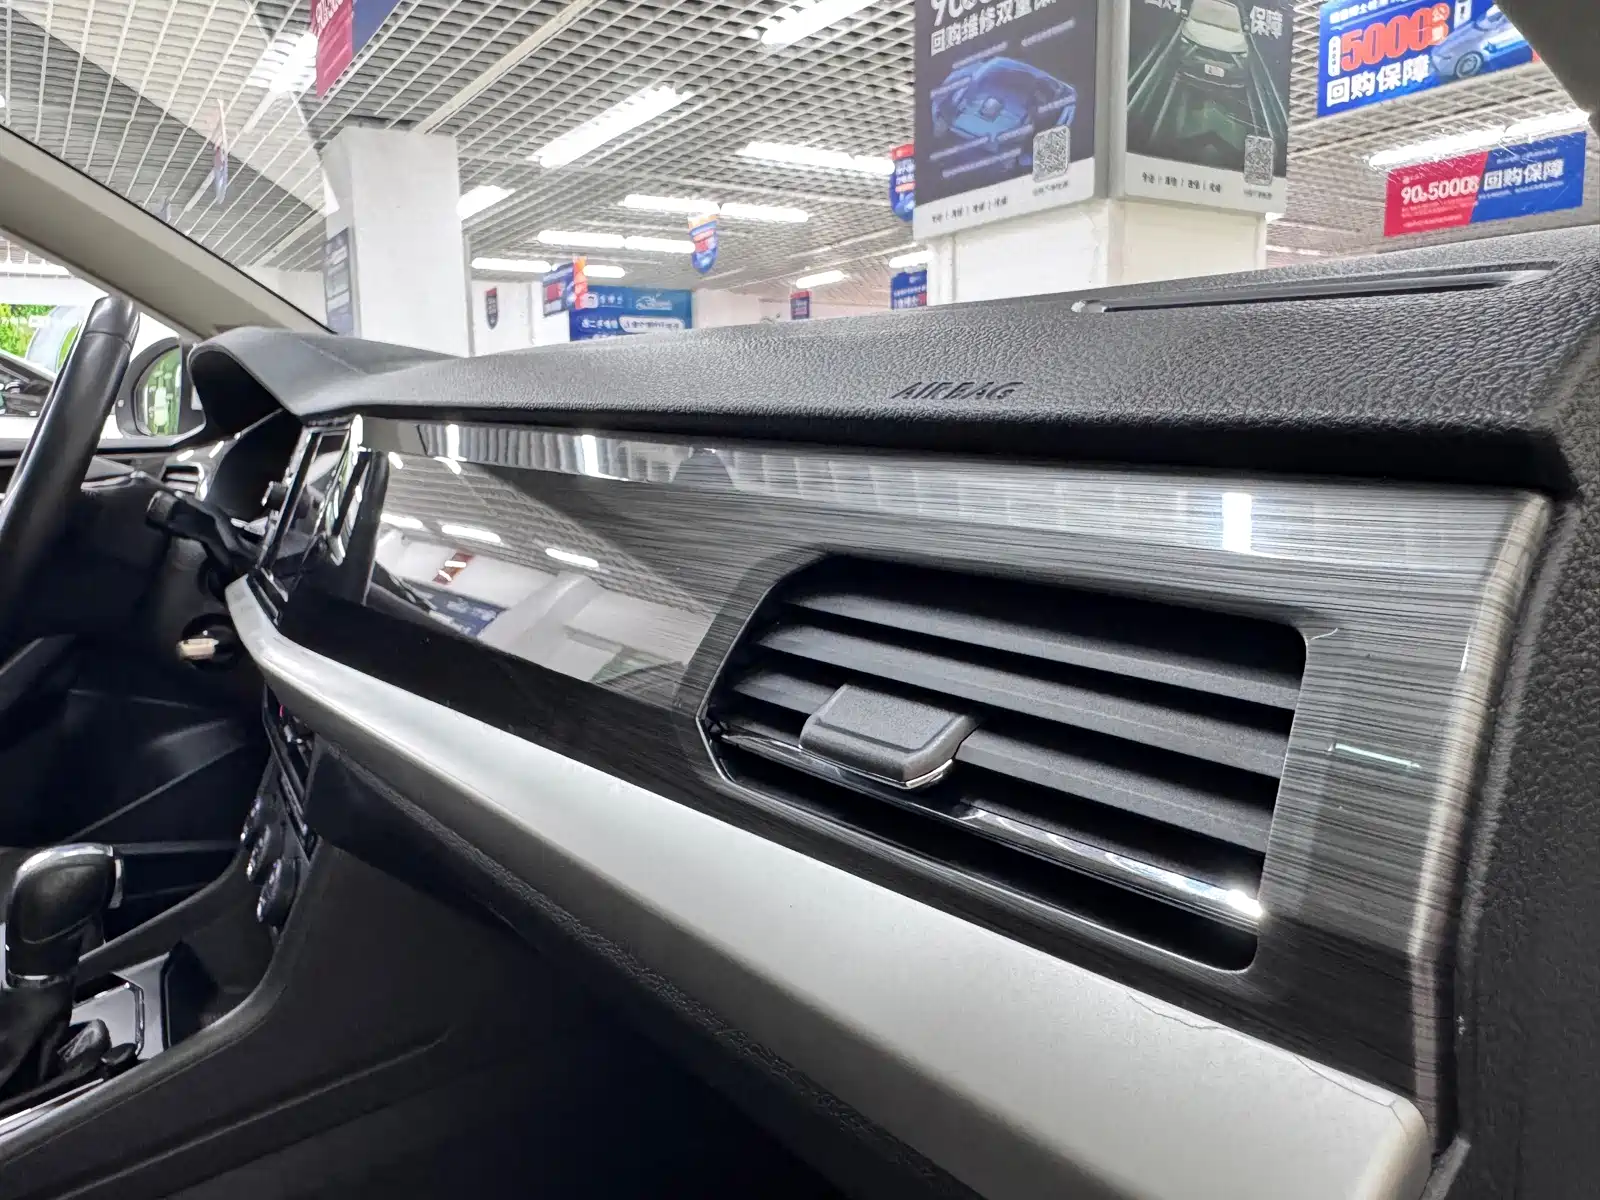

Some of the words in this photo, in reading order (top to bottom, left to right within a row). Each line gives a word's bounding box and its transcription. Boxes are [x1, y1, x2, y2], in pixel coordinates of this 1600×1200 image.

[1250, 5, 1284, 40] 保障
[1326, 54, 1430, 107] 回购保障
[1484, 158, 1565, 191] 回购保障
[891, 381, 1024, 400] AIRBAG
